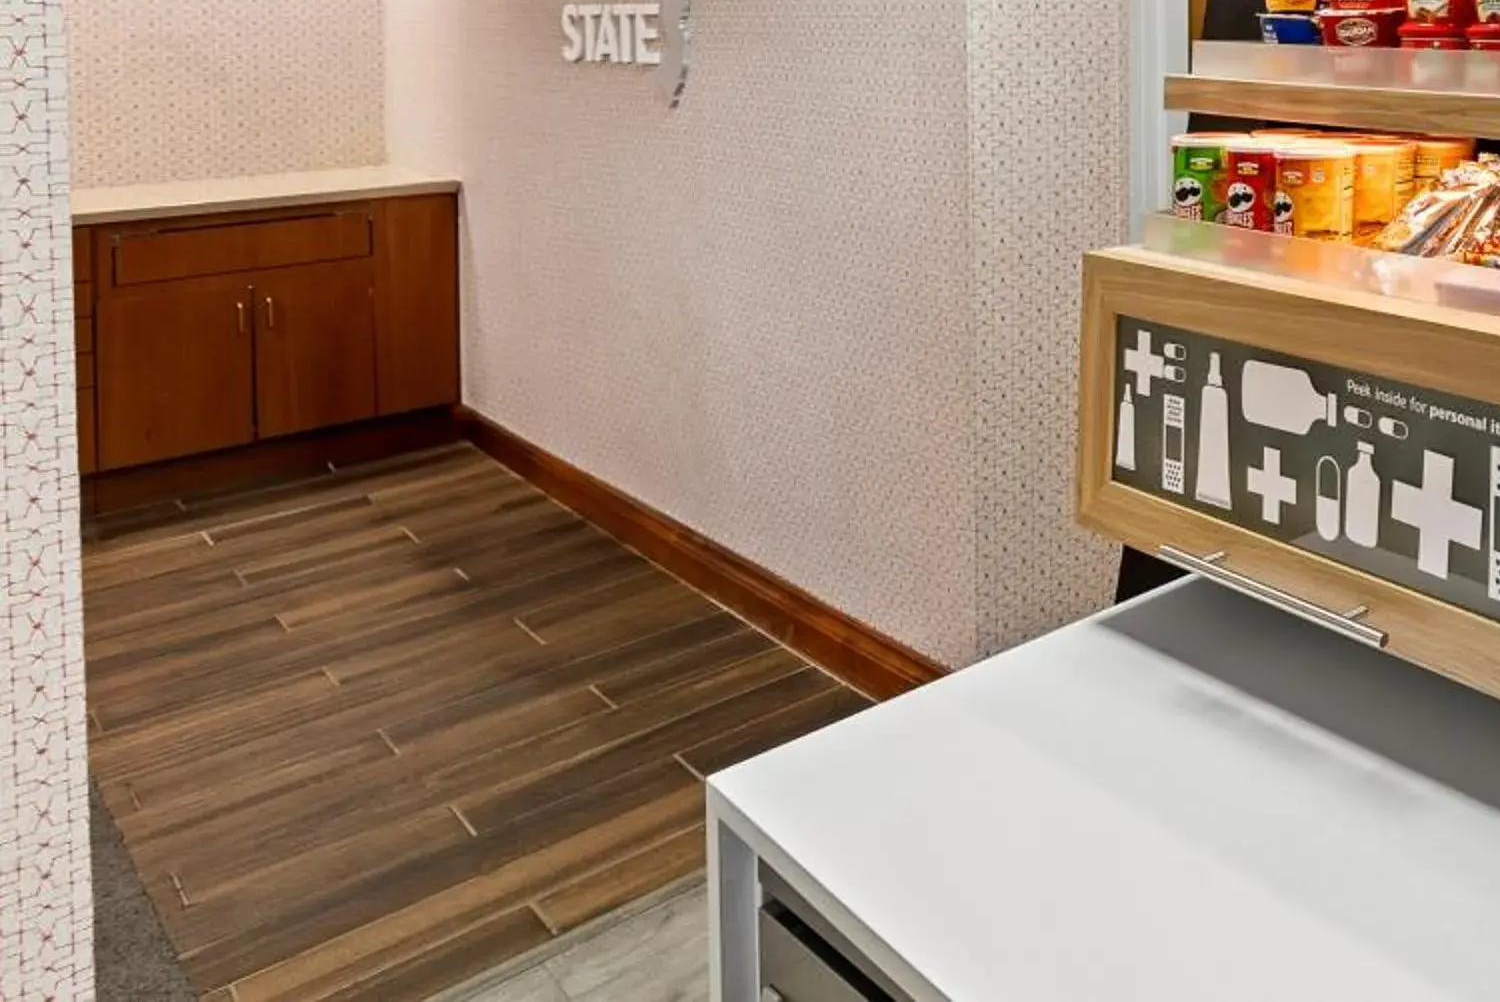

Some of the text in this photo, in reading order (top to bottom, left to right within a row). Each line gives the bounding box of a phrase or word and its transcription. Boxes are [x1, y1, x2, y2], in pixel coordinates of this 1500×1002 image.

[561, 3, 661, 65] STATE
[1347, 378, 1371, 397] Peek
[1375, 386, 1407, 410] inside
[1409, 396, 1427, 414] for
[1429, 404, 1487, 431] personal
